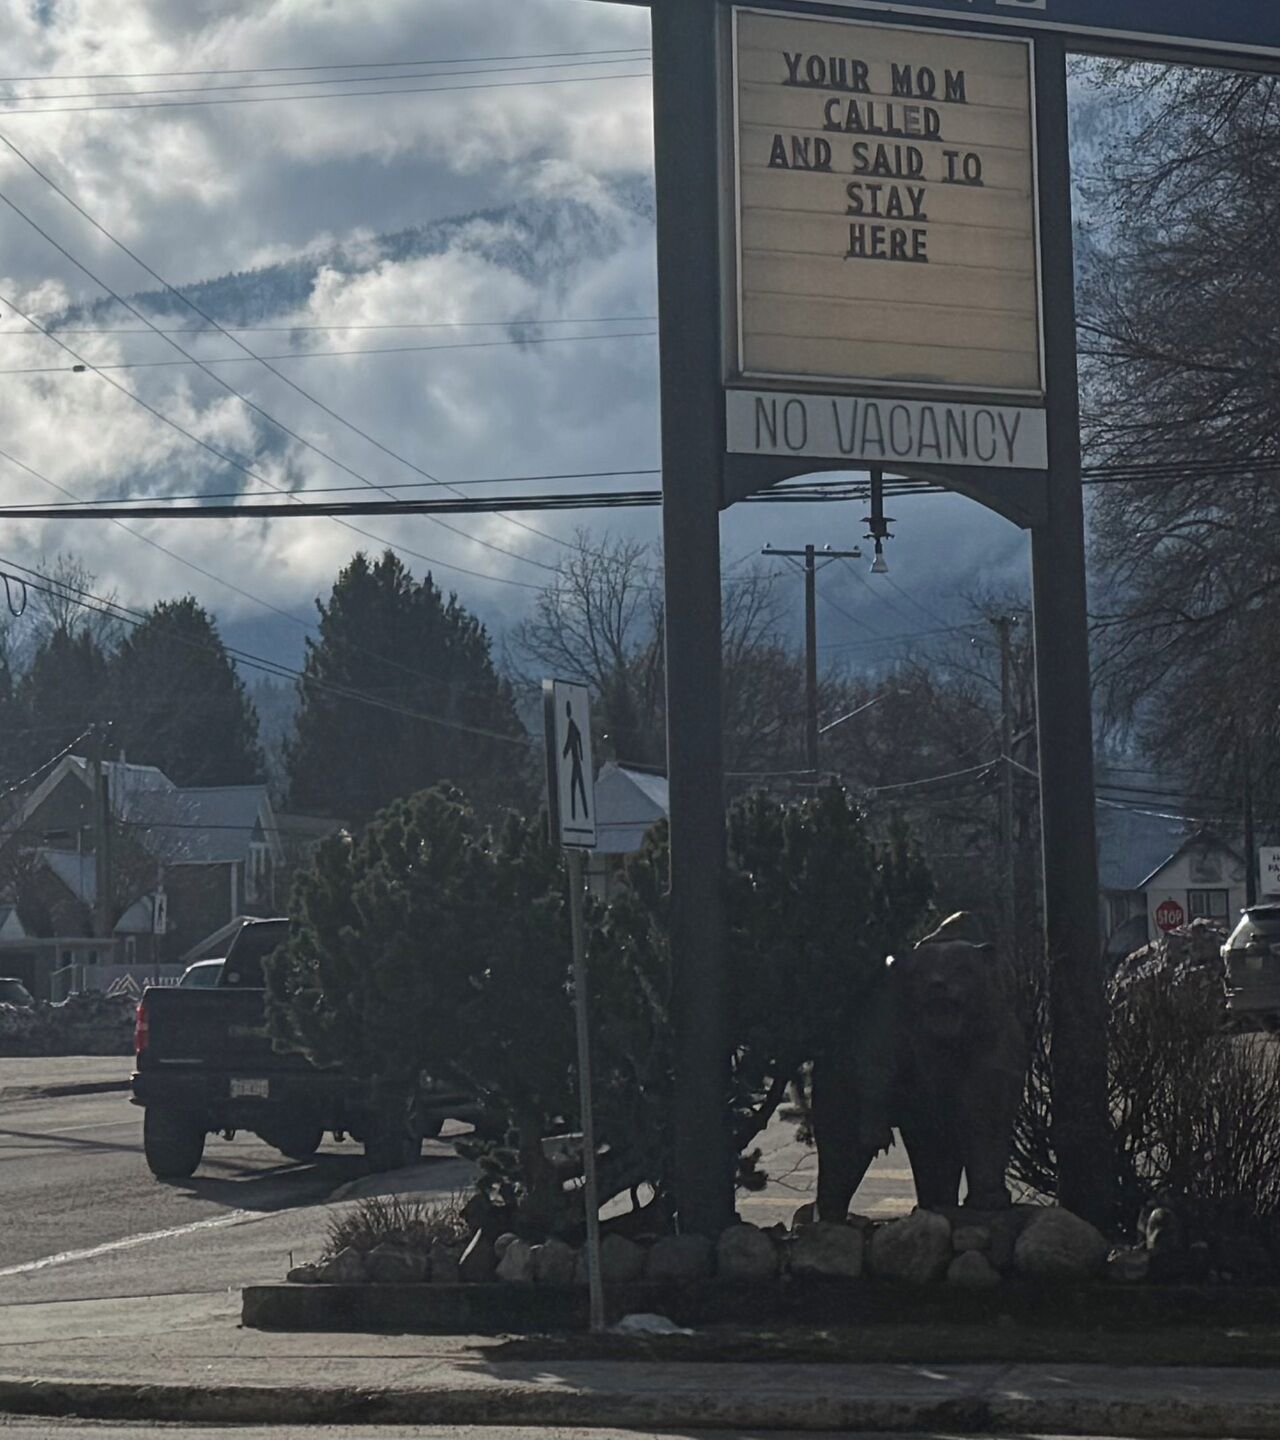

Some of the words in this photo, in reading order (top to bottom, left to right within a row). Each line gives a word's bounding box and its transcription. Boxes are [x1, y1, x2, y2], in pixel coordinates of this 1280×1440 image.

[782, 51, 870, 93] YOUR
[890, 62, 967, 103] MOM
[823, 97, 942, 141] CALLED
[768, 133, 832, 172] AND
[852, 141, 926, 181] SAID
[941, 149, 984, 186] TO
[845, 181, 928, 221] STAY
[846, 223, 928, 262] HERE
[754, 396, 808, 451] NO
[831, 398, 1021, 463] VACANCY
[1157, 908, 1182, 925] STOP
